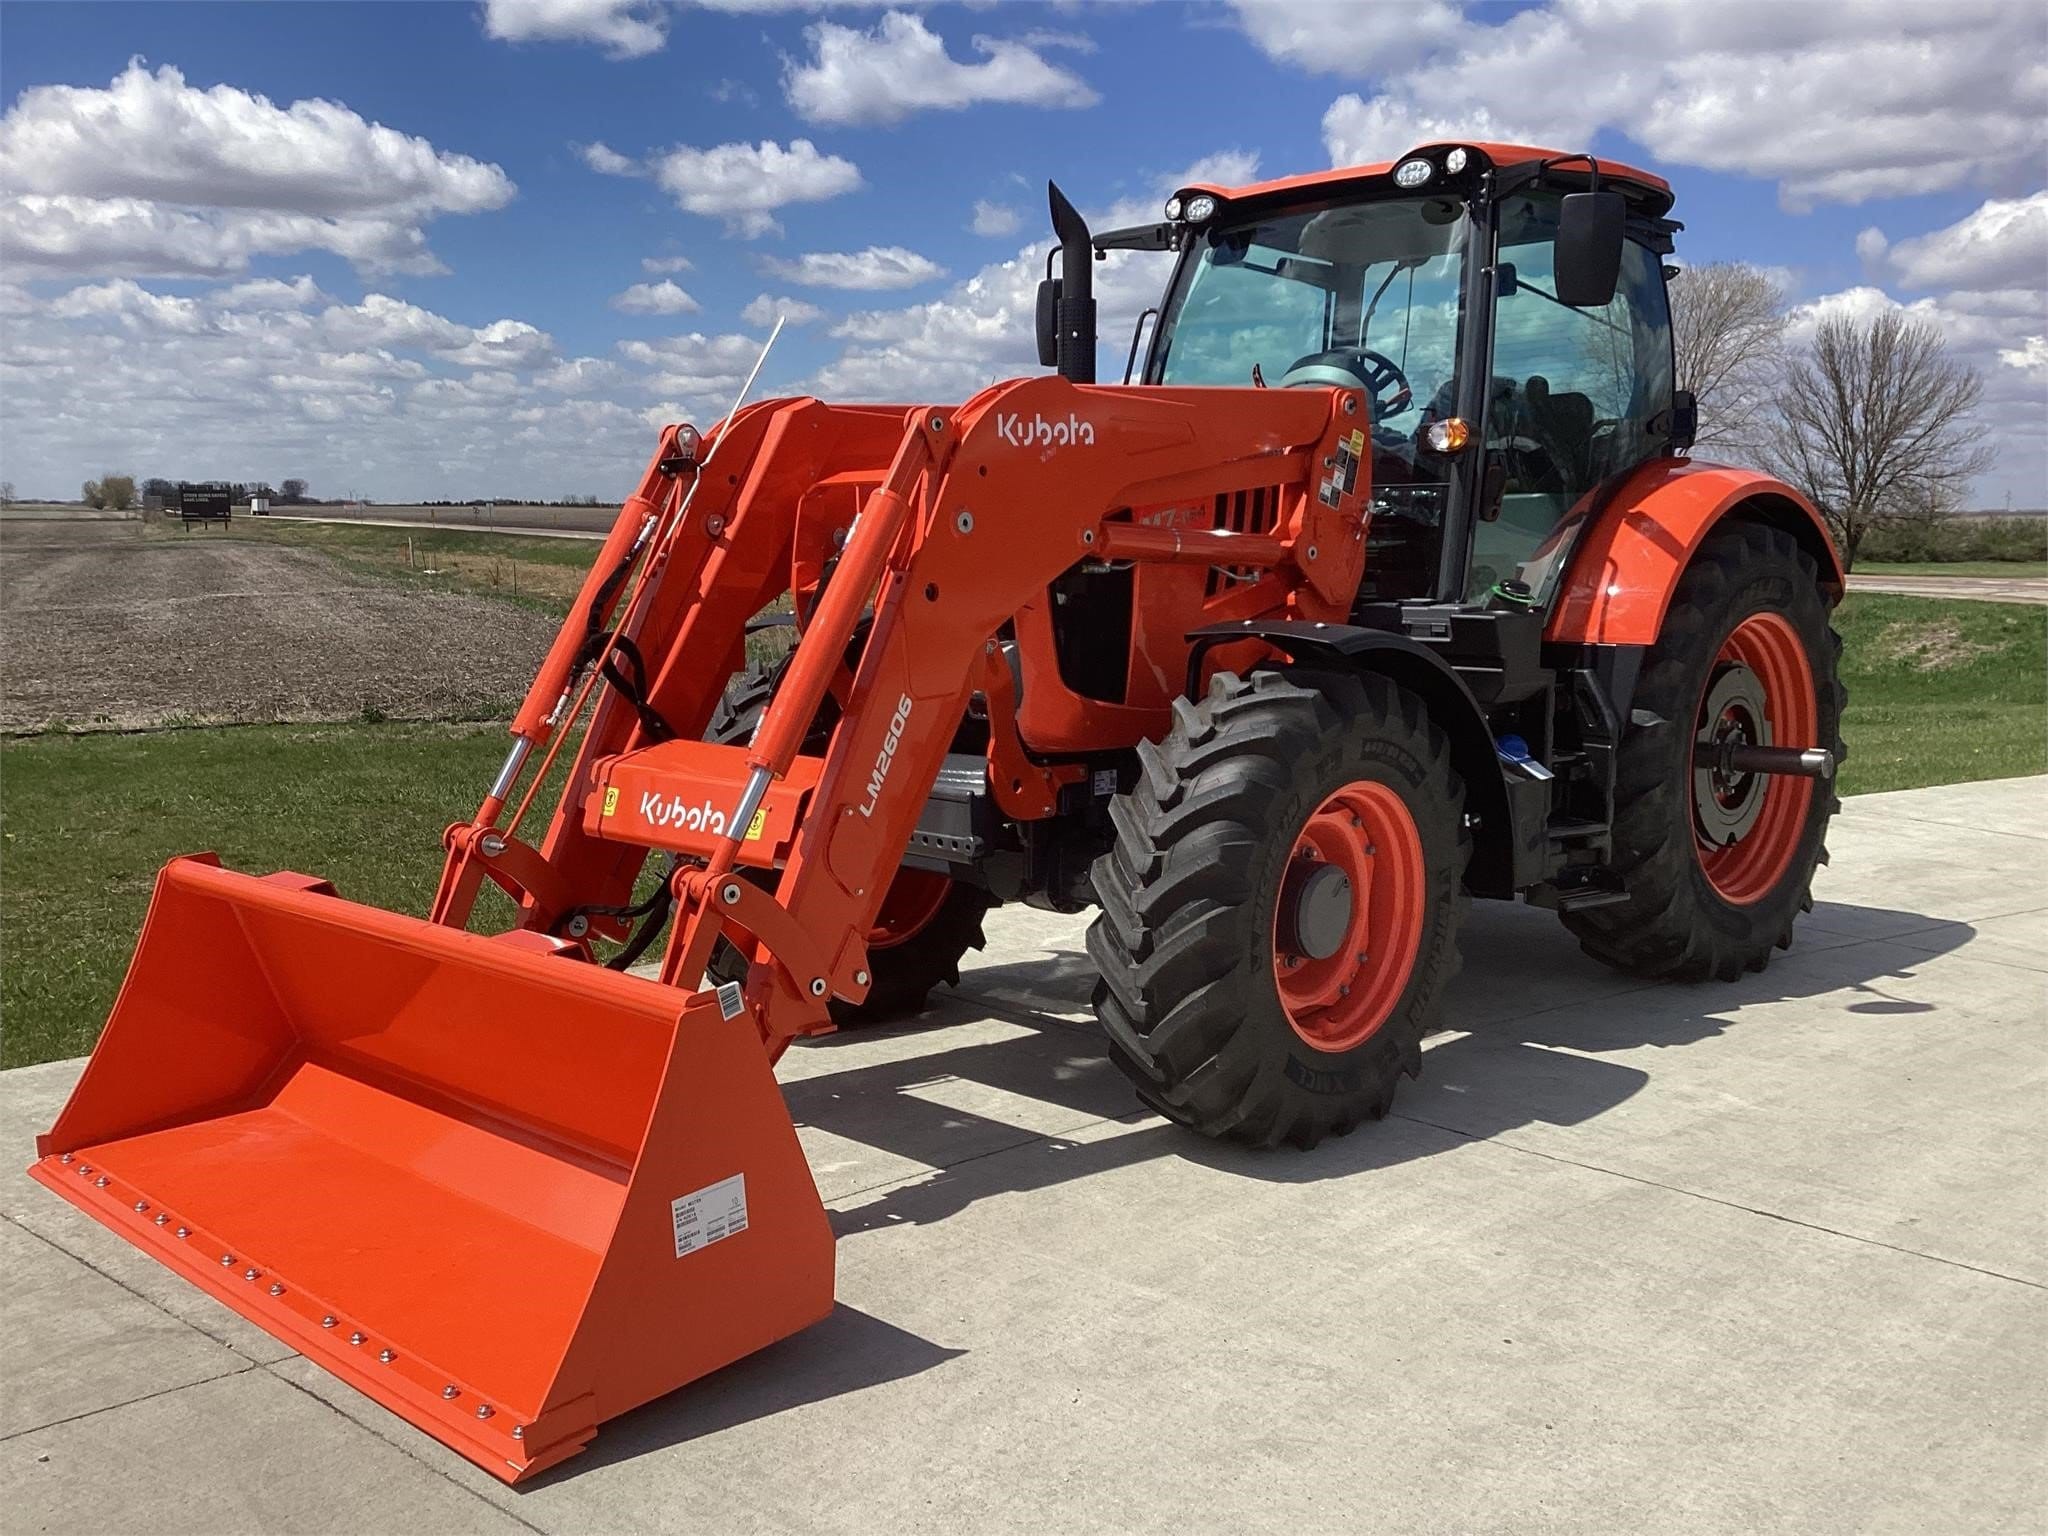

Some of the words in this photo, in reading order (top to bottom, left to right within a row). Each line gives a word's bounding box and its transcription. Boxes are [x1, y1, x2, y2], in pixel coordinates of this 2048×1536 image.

[997, 412, 1095, 447] Kubota
[859, 692, 913, 818] LM2606
[639, 791, 726, 836] Kubota
